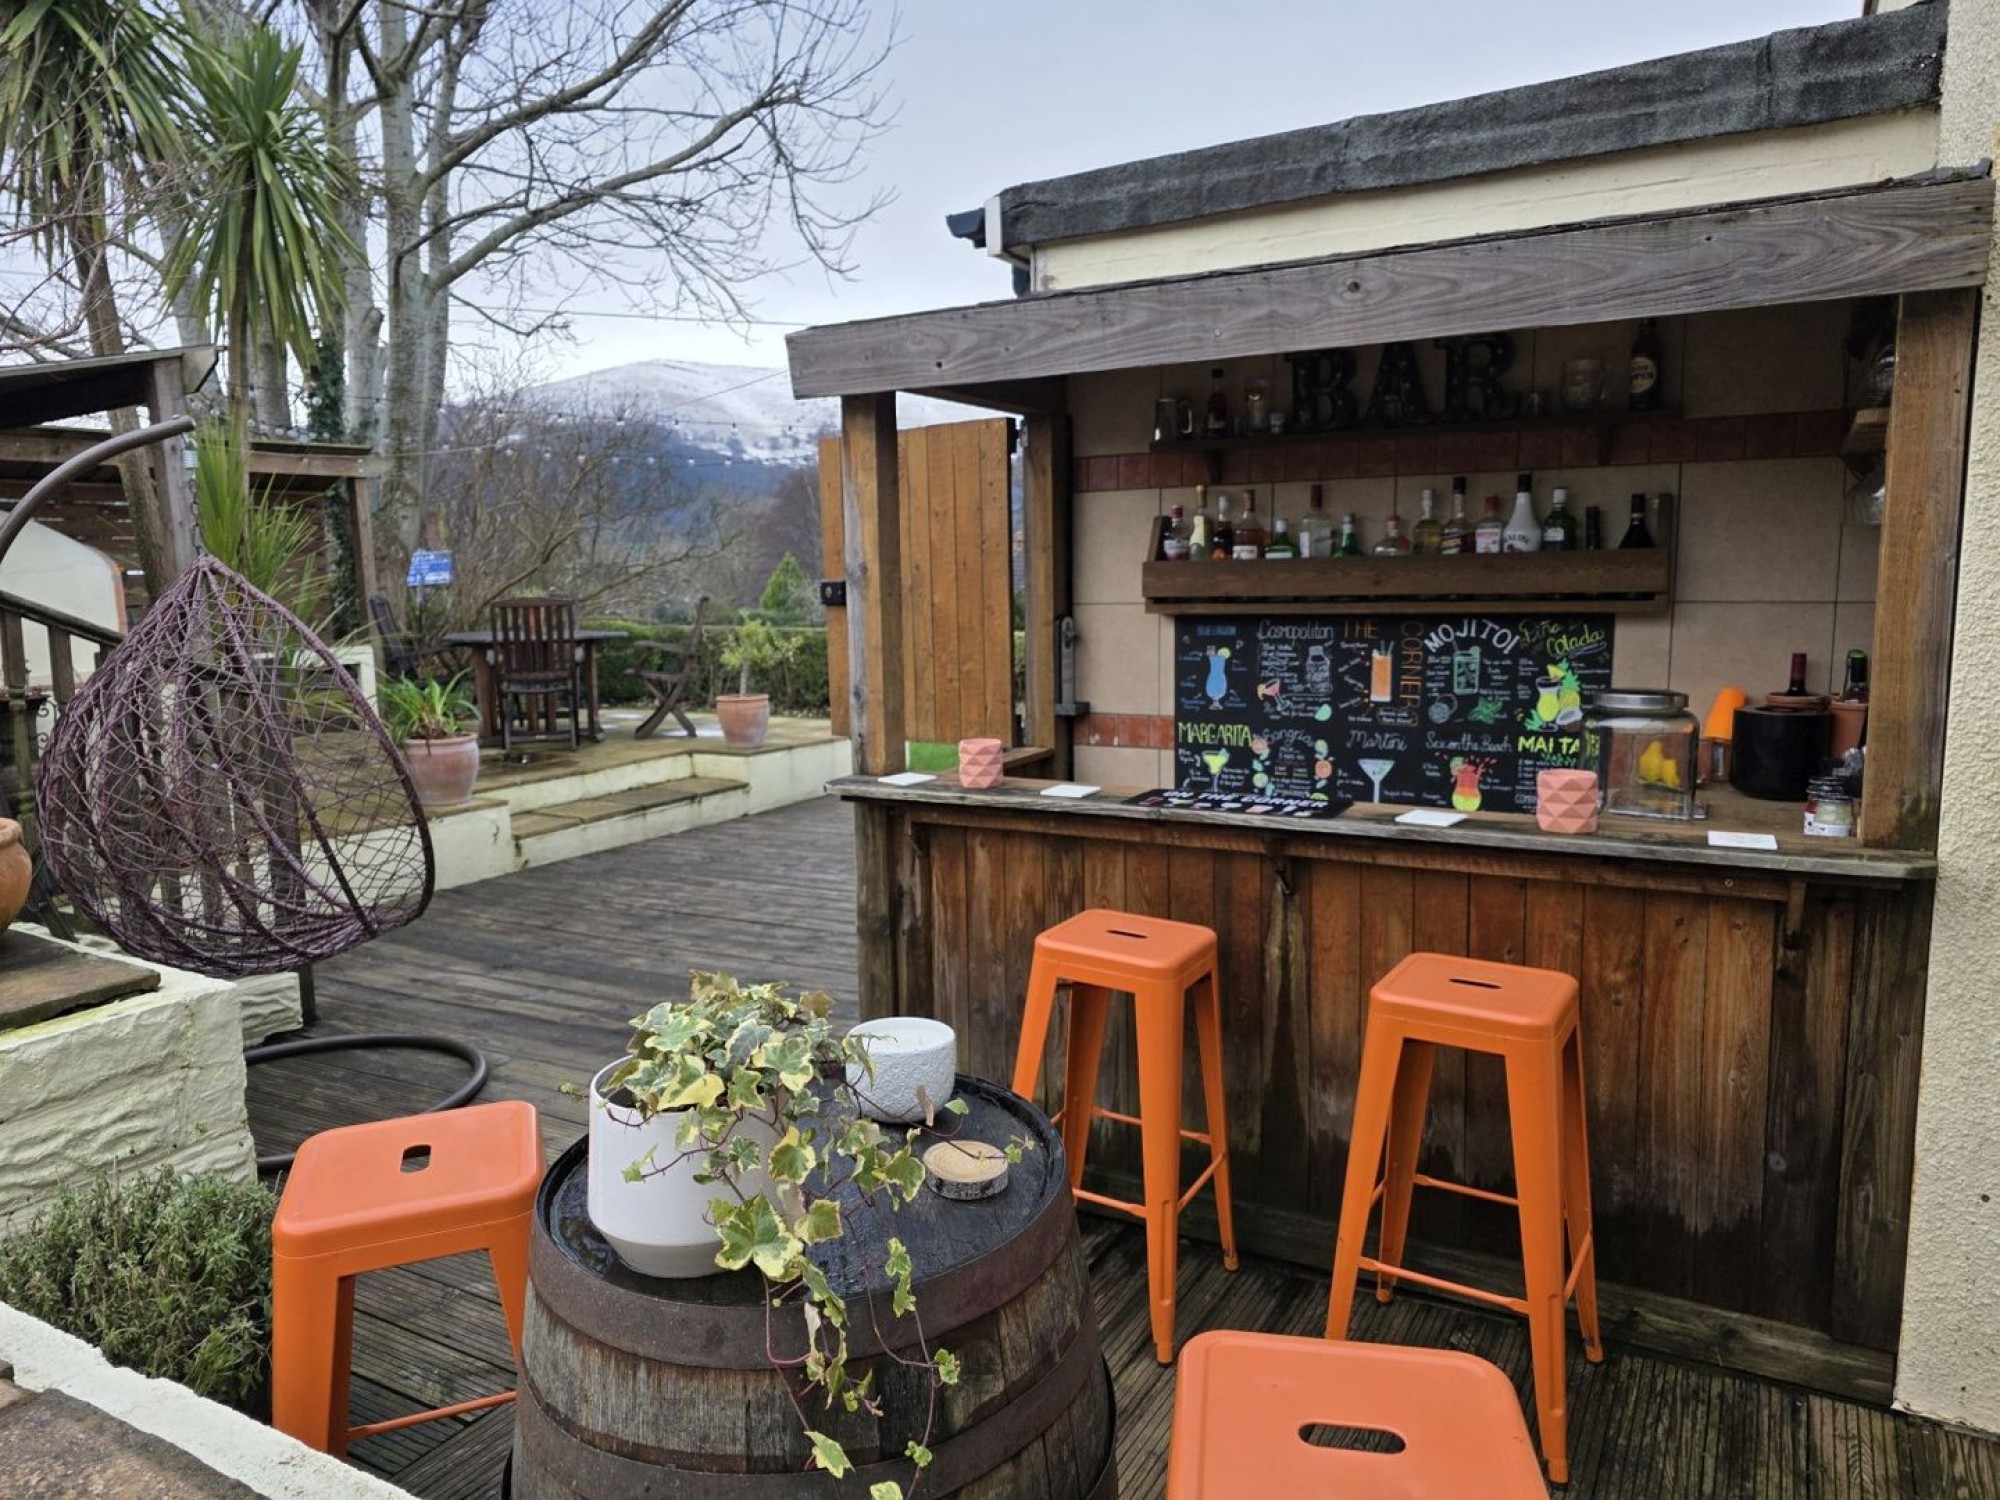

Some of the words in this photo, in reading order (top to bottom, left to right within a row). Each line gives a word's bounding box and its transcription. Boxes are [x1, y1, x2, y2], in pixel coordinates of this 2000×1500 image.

[1286, 334, 1519, 432] BAR
[1343, 620, 1379, 640] THE
[1545, 623, 1606, 659] Colada
[1400, 621, 1424, 709] CORNER
[1178, 721, 1252, 747] MARGARITA
[1517, 735, 1555, 755] MAI
[1197, 791, 1238, 801] THE
[1241, 794, 1330, 808] CORNER
